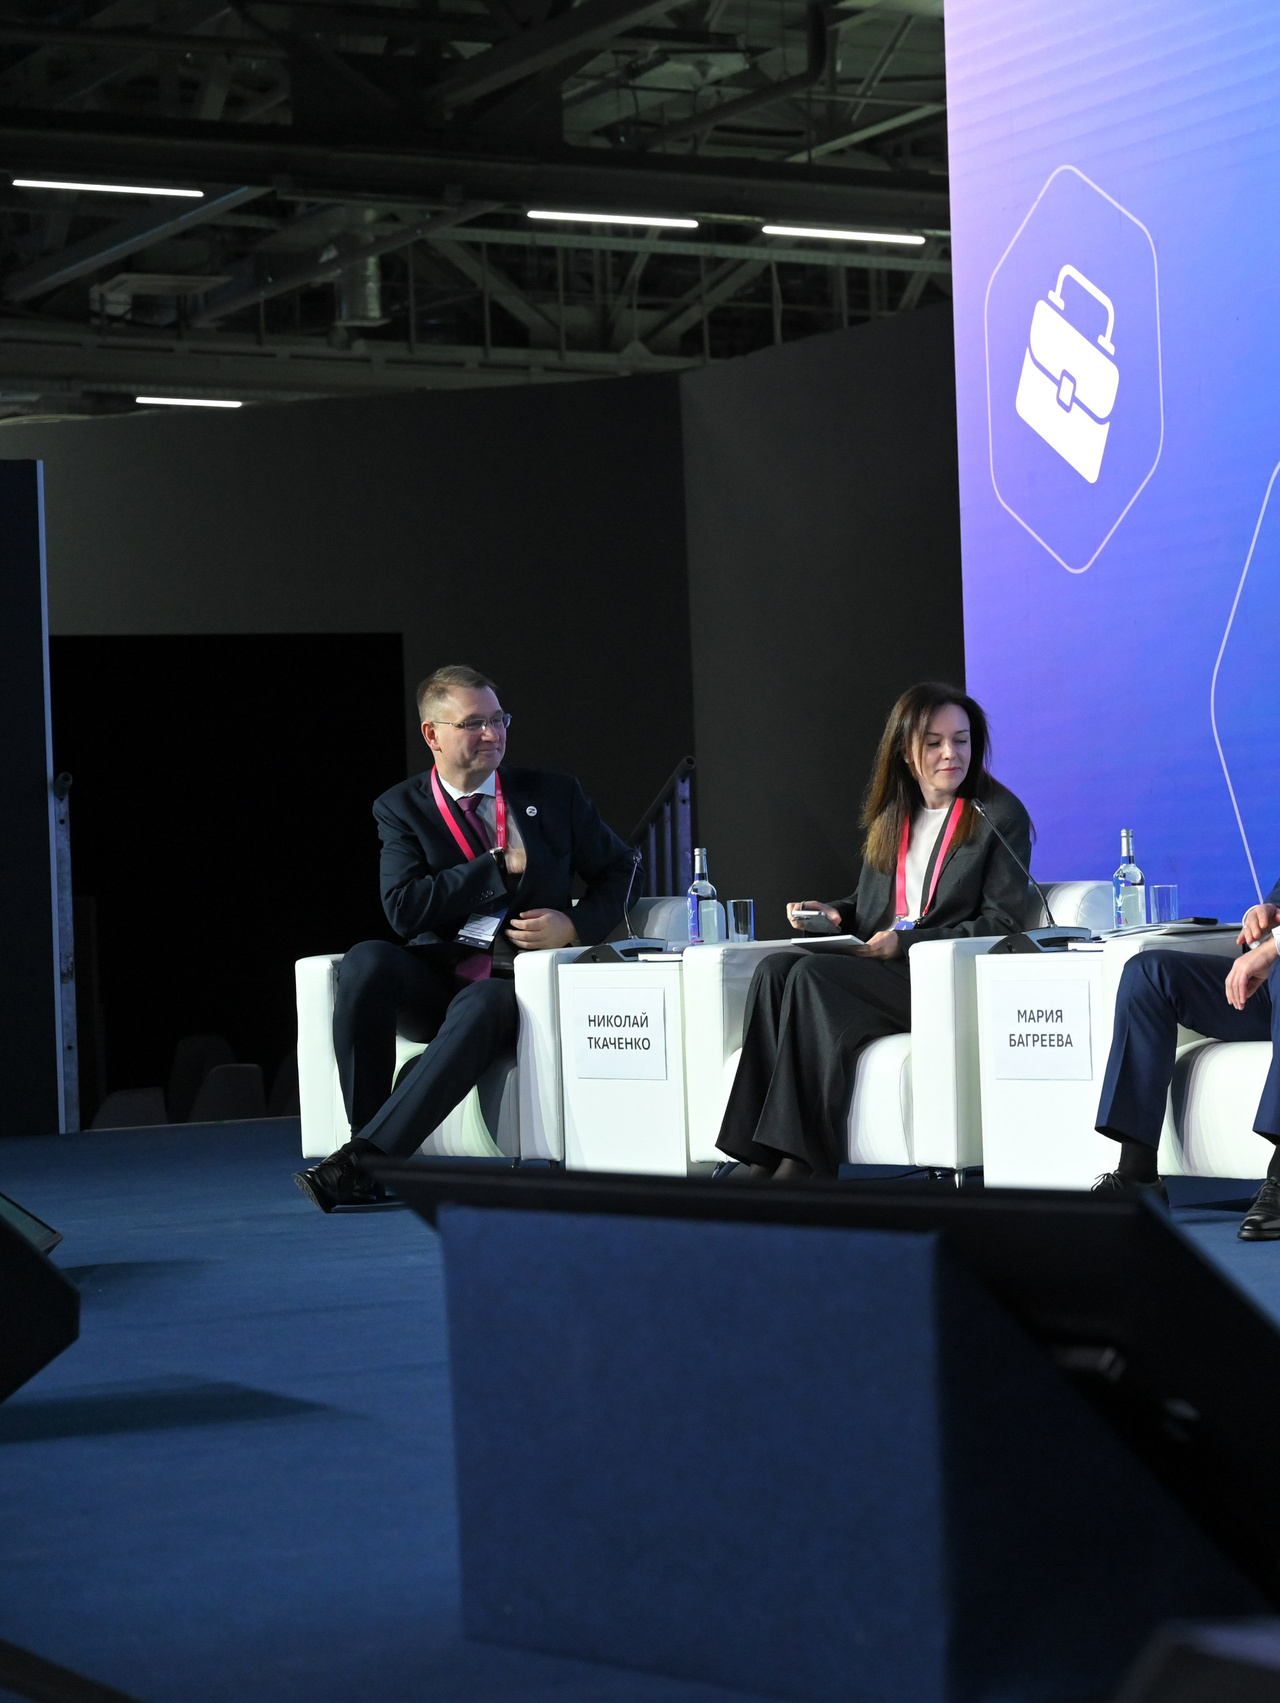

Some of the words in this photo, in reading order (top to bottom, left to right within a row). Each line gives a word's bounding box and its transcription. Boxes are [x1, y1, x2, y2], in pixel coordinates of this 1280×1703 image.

[588, 1011, 649, 1028] НИКОЛАЙ
[1017, 1009, 1063, 1023] МАРИЯ
[587, 1036, 651, 1050] ТКАЧЕНКО
[1009, 1033, 1073, 1047] БАГРЕЕВА
